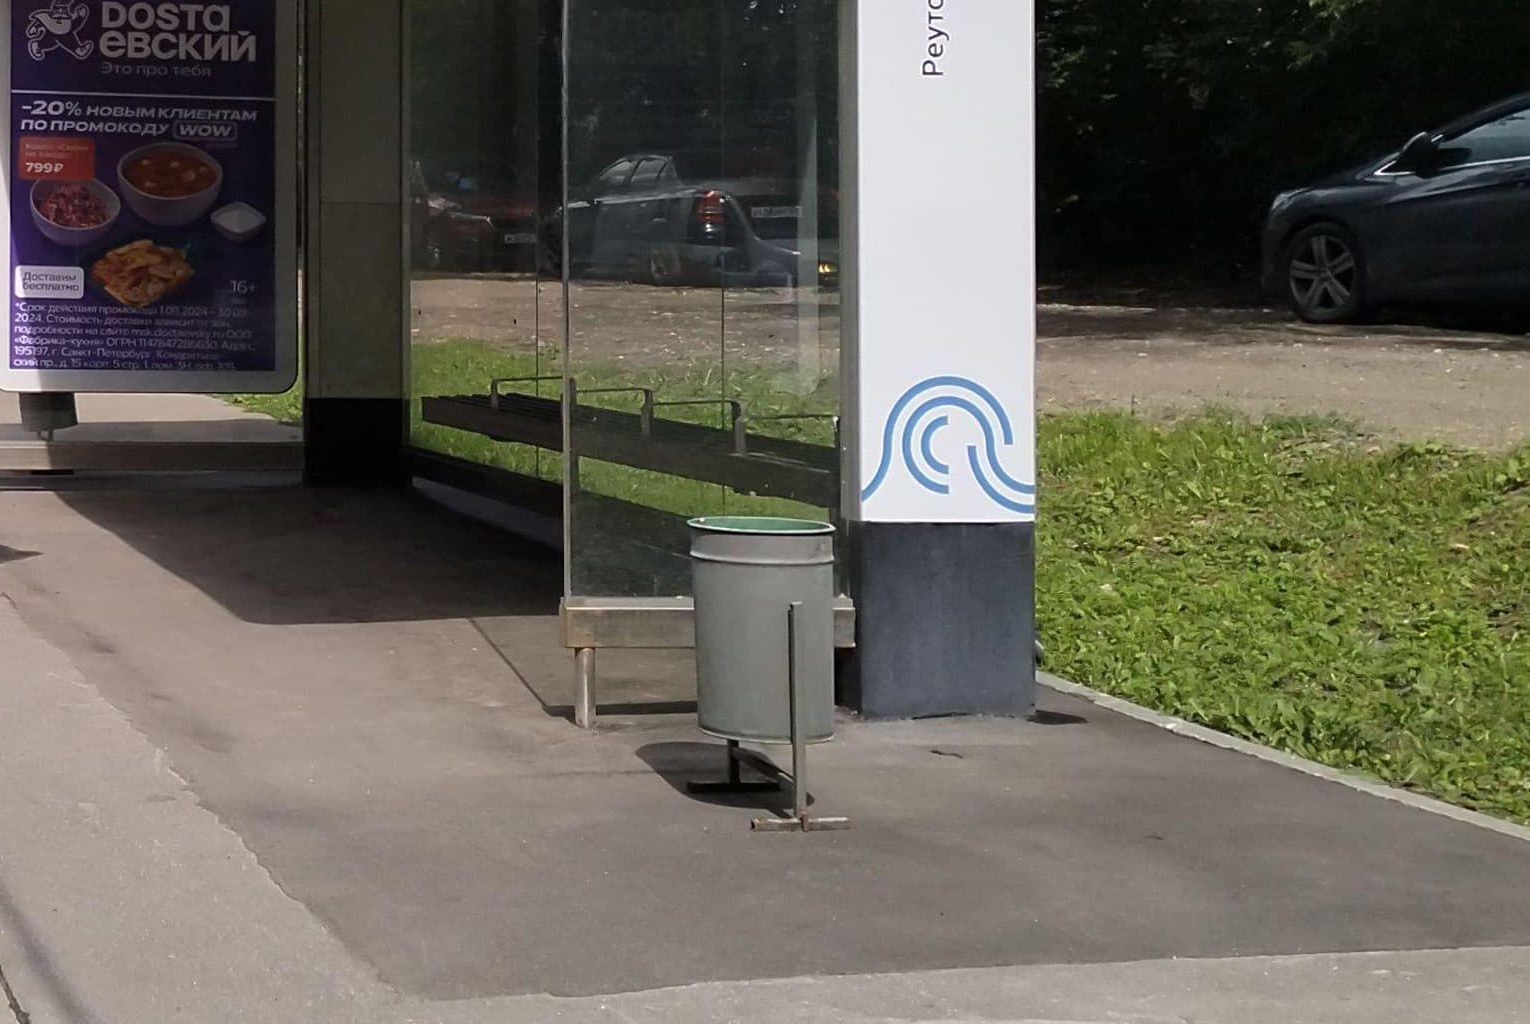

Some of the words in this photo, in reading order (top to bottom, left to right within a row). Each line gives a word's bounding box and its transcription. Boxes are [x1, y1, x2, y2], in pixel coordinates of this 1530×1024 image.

[101, 63, 133, 75] Это
[136, 64, 168, 77] про
[174, 62, 212, 78] тебя
[21, 100, 82, 116] -20%
[85, 105, 156, 118] НОВЫМ
[157, 107, 258, 121] КЛИЕНТАМ
[20, 119, 48, 131] ПО
[49, 120, 170, 136] ПРОМОКОДУ
[179, 124, 233, 137] WOW
[22, 272, 77, 282] Доставим
[22, 282, 79, 292] бесплатно
